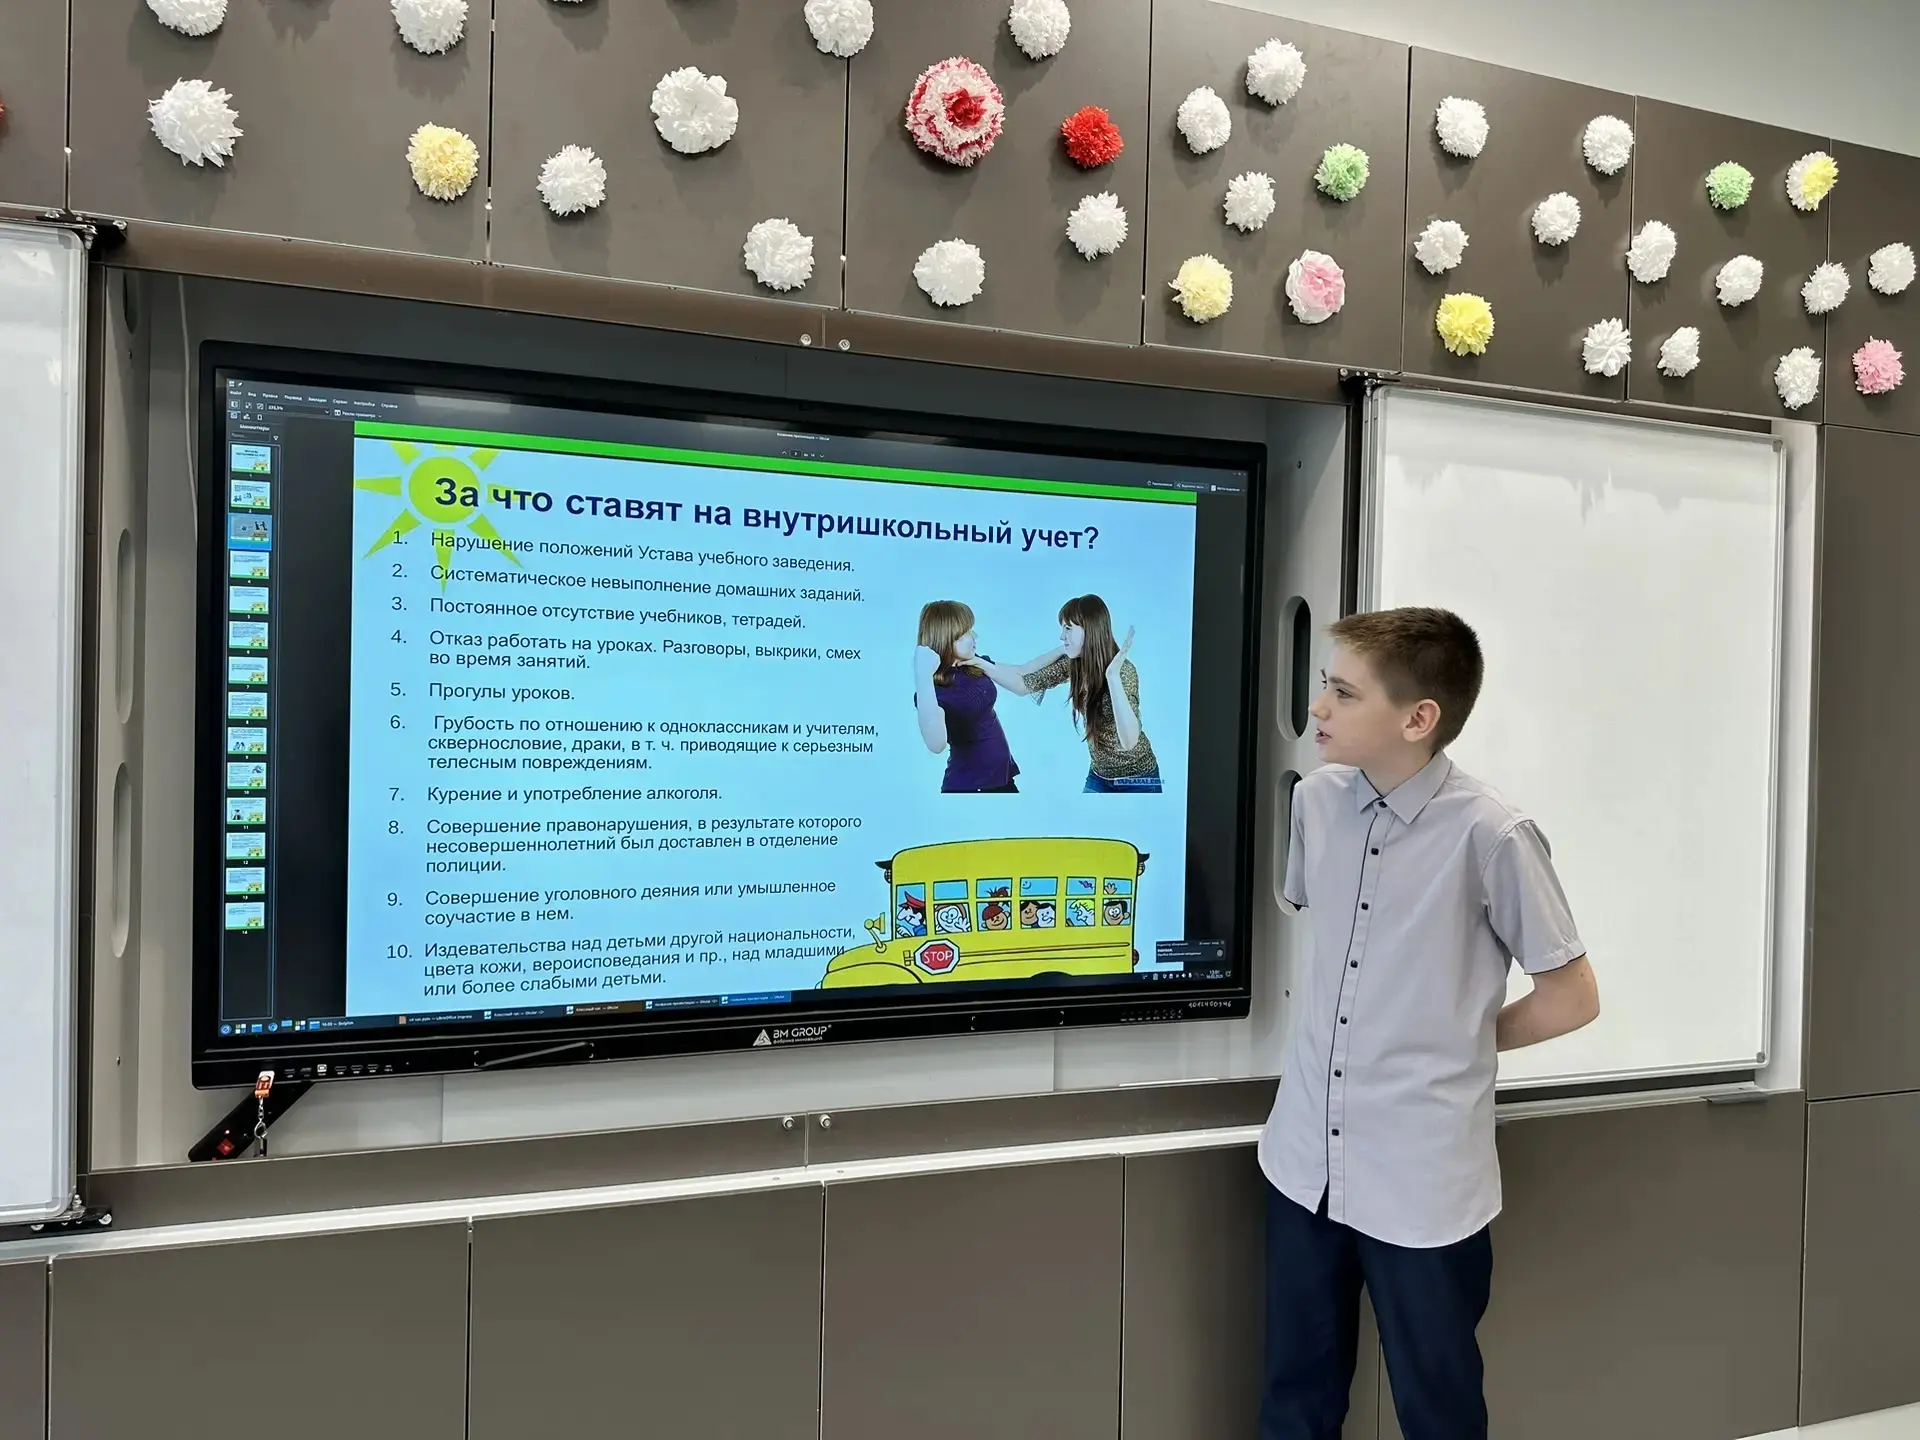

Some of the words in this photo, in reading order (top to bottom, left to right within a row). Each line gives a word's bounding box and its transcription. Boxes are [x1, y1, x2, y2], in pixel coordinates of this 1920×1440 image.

[435, 477, 478, 507] За
[492, 488, 552, 512] что
[565, 494, 682, 521] ставят
[694, 504, 731, 525] на
[743, 508, 1012, 544] внутришкольный
[1021, 526, 1099, 551] учет?
[393, 530, 407, 544] 1.
[431, 532, 533, 551] Нарушение
[539, 542, 632, 558] положений
[638, 545, 692, 561] Устава
[698, 551, 768, 566] учебного
[772, 557, 854, 571] заведения.
[392, 563, 407, 577] 2.
[430, 564, 586, 587] Систематическое
[591, 577, 711, 593] невыполнение
[715, 584, 795, 598] домашних
[800, 588, 864, 601] заданий.
[391, 596, 406, 610] 3.
[430, 597, 537, 616] Постоянное
[542, 606, 634, 621] отсутствие
[639, 609, 725, 626] учебников,
[731, 614, 805, 629] тетрадей.
[390, 629, 406, 643] 4.
[429, 630, 482, 646] Отказ
[487, 633, 566, 649] работать
[572, 639, 591, 650] на
[597, 640, 656, 654] уроках.
[663, 639, 749, 658] Разговоры,
[755, 646, 820, 660] выкрики,
[825, 648, 860, 659] смех
[429, 653, 450, 664] во
[456, 654, 510, 668] время
[516, 654, 589, 668] занятий.
[390, 682, 405, 696] 5.
[429, 682, 505, 701] Прогулы
[511, 688, 574, 702] уроков.
[390, 714, 405, 729] 6.
[434, 715, 514, 733] Грубость
[519, 720, 539, 730] по
[545, 720, 642, 731] отношению
[647, 722, 655, 731] к
[659, 722, 788, 734] одноклассникам
[793, 724, 801, 733] и
[806, 724, 878, 737] учителям,
[428, 738, 566, 752] сквернословие,
[571, 739, 624, 753] драки,
[631, 740, 640, 750] в
[645, 740, 655, 750] т.
[661, 740, 673, 750] ч.
[680, 740, 776, 754] приводящие
[781, 742, 788, 751] к
[793, 741, 872, 755] серьезным
[427, 757, 516, 768] телесным
[522, 758, 651, 772] повреждениям.
[389, 787, 404, 800] 7.
[427, 786, 501, 804] Курение
[507, 789, 517, 800] и
[523, 786, 641, 803] употребление
[646, 789, 721, 799] алкоголя.
[388, 820, 403, 834] 8.
[426, 819, 540, 836] Совершение
[546, 819, 691, 834] правонарушения,
[698, 819, 706, 829] в
[711, 818, 794, 832] результате
[798, 817, 861, 830] которого
[426, 836, 615, 855] несовершеннолетний
[620, 835, 653, 849] был
[658, 837, 741, 850] доставлен
[746, 836, 754, 846] в
[759, 835, 837, 848] отделение
[426, 860, 505, 873] полиции.
[387, 892, 402, 906] 9.
[425, 890, 539, 907] Совершение
[544, 887, 636, 904] уголовного
[640, 886, 699, 900] деяния
[704, 885, 732, 895] или
[737, 881, 835, 897] умышленное
[424, 911, 515, 927] соучастие
[520, 910, 530, 921] в
[536, 909, 573, 920] нем.
[387, 944, 412, 958] 10.
[425, 940, 565, 958] Издевательства
[571, 939, 601, 952] над
[606, 936, 665, 950] детьми
[669, 930, 722, 948] другой
[728, 928, 854, 943] национальности,
[424, 963, 473, 978] цвета
[480, 961, 525, 973] кожи,
[532, 953, 679, 973] вероисповедания
[685, 952, 693, 962] и
[699, 951, 726, 964] пр.,
[732, 949, 759, 962] над
[766, 945, 845, 960] младшими
[923, 951, 953, 964] STOP
[424, 984, 455, 996] или
[462, 979, 514, 994] более
[520, 975, 596, 991] слабыми
[601, 973, 665, 988] детьми.
[773, 1029, 789, 1039] BM
[791, 1026, 828, 1038] GROUP
